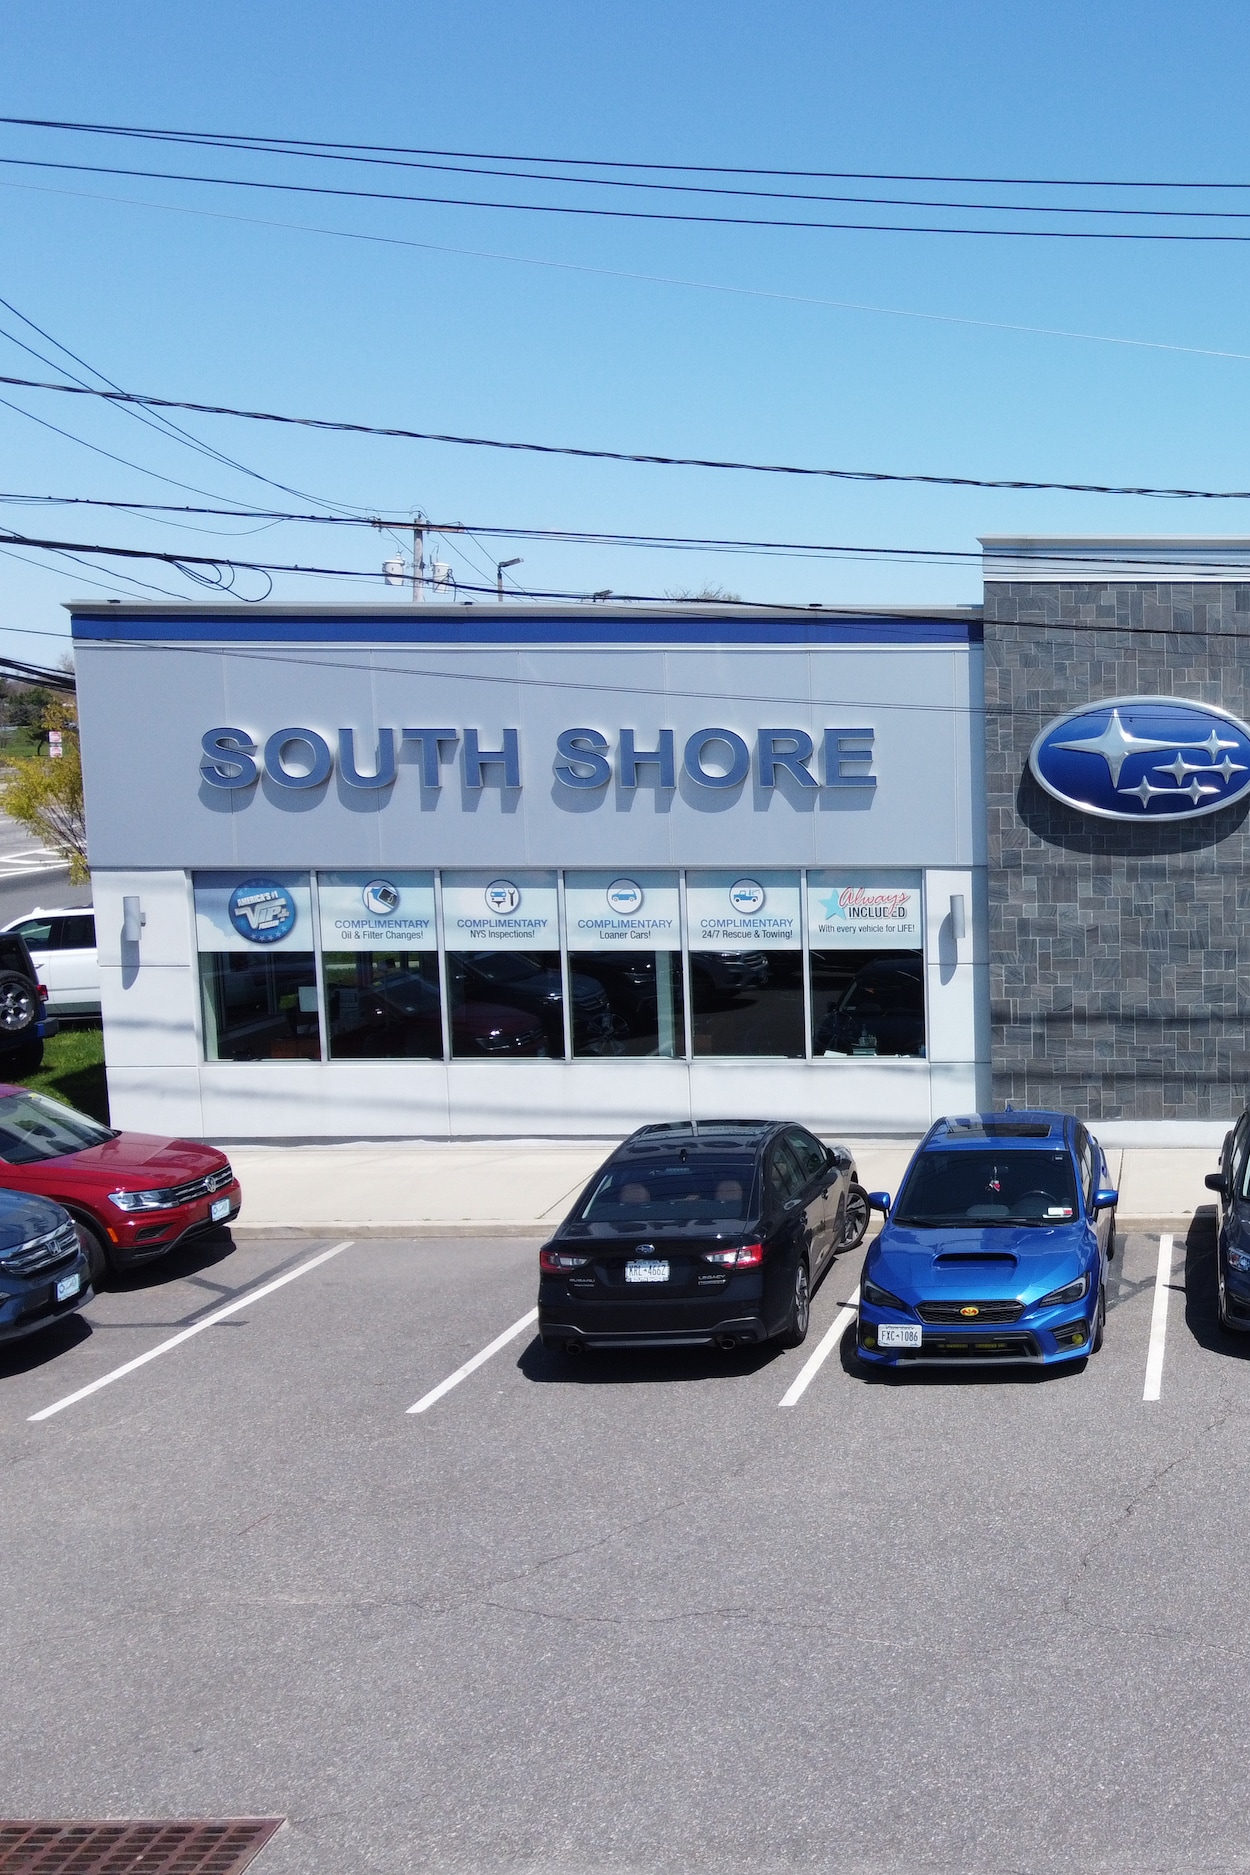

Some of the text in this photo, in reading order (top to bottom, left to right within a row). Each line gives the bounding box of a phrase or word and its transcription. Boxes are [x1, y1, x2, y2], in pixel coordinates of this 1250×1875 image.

[200, 727, 878, 789] SOUTH SHORE
[839, 886, 911, 915] Always
[848, 906, 906, 918] INCLUDED
[334, 919, 430, 929] COMPLIMENTARY
[456, 919, 548, 928] COMPLIMENTARY
[577, 919, 673, 929] COMPLIMENTARY
[700, 918, 794, 928] COMPLIMENTARY
[470, 929, 535, 940] NYS Inspections!
[599, 930, 651, 940] Loaner Cars!
[701, 929, 793, 940] 24/7 Rescue & Towing!
[818, 924, 915, 935] With every vehicle for LIFE!
[341, 930, 424, 941] Oil & Filter Changes!
